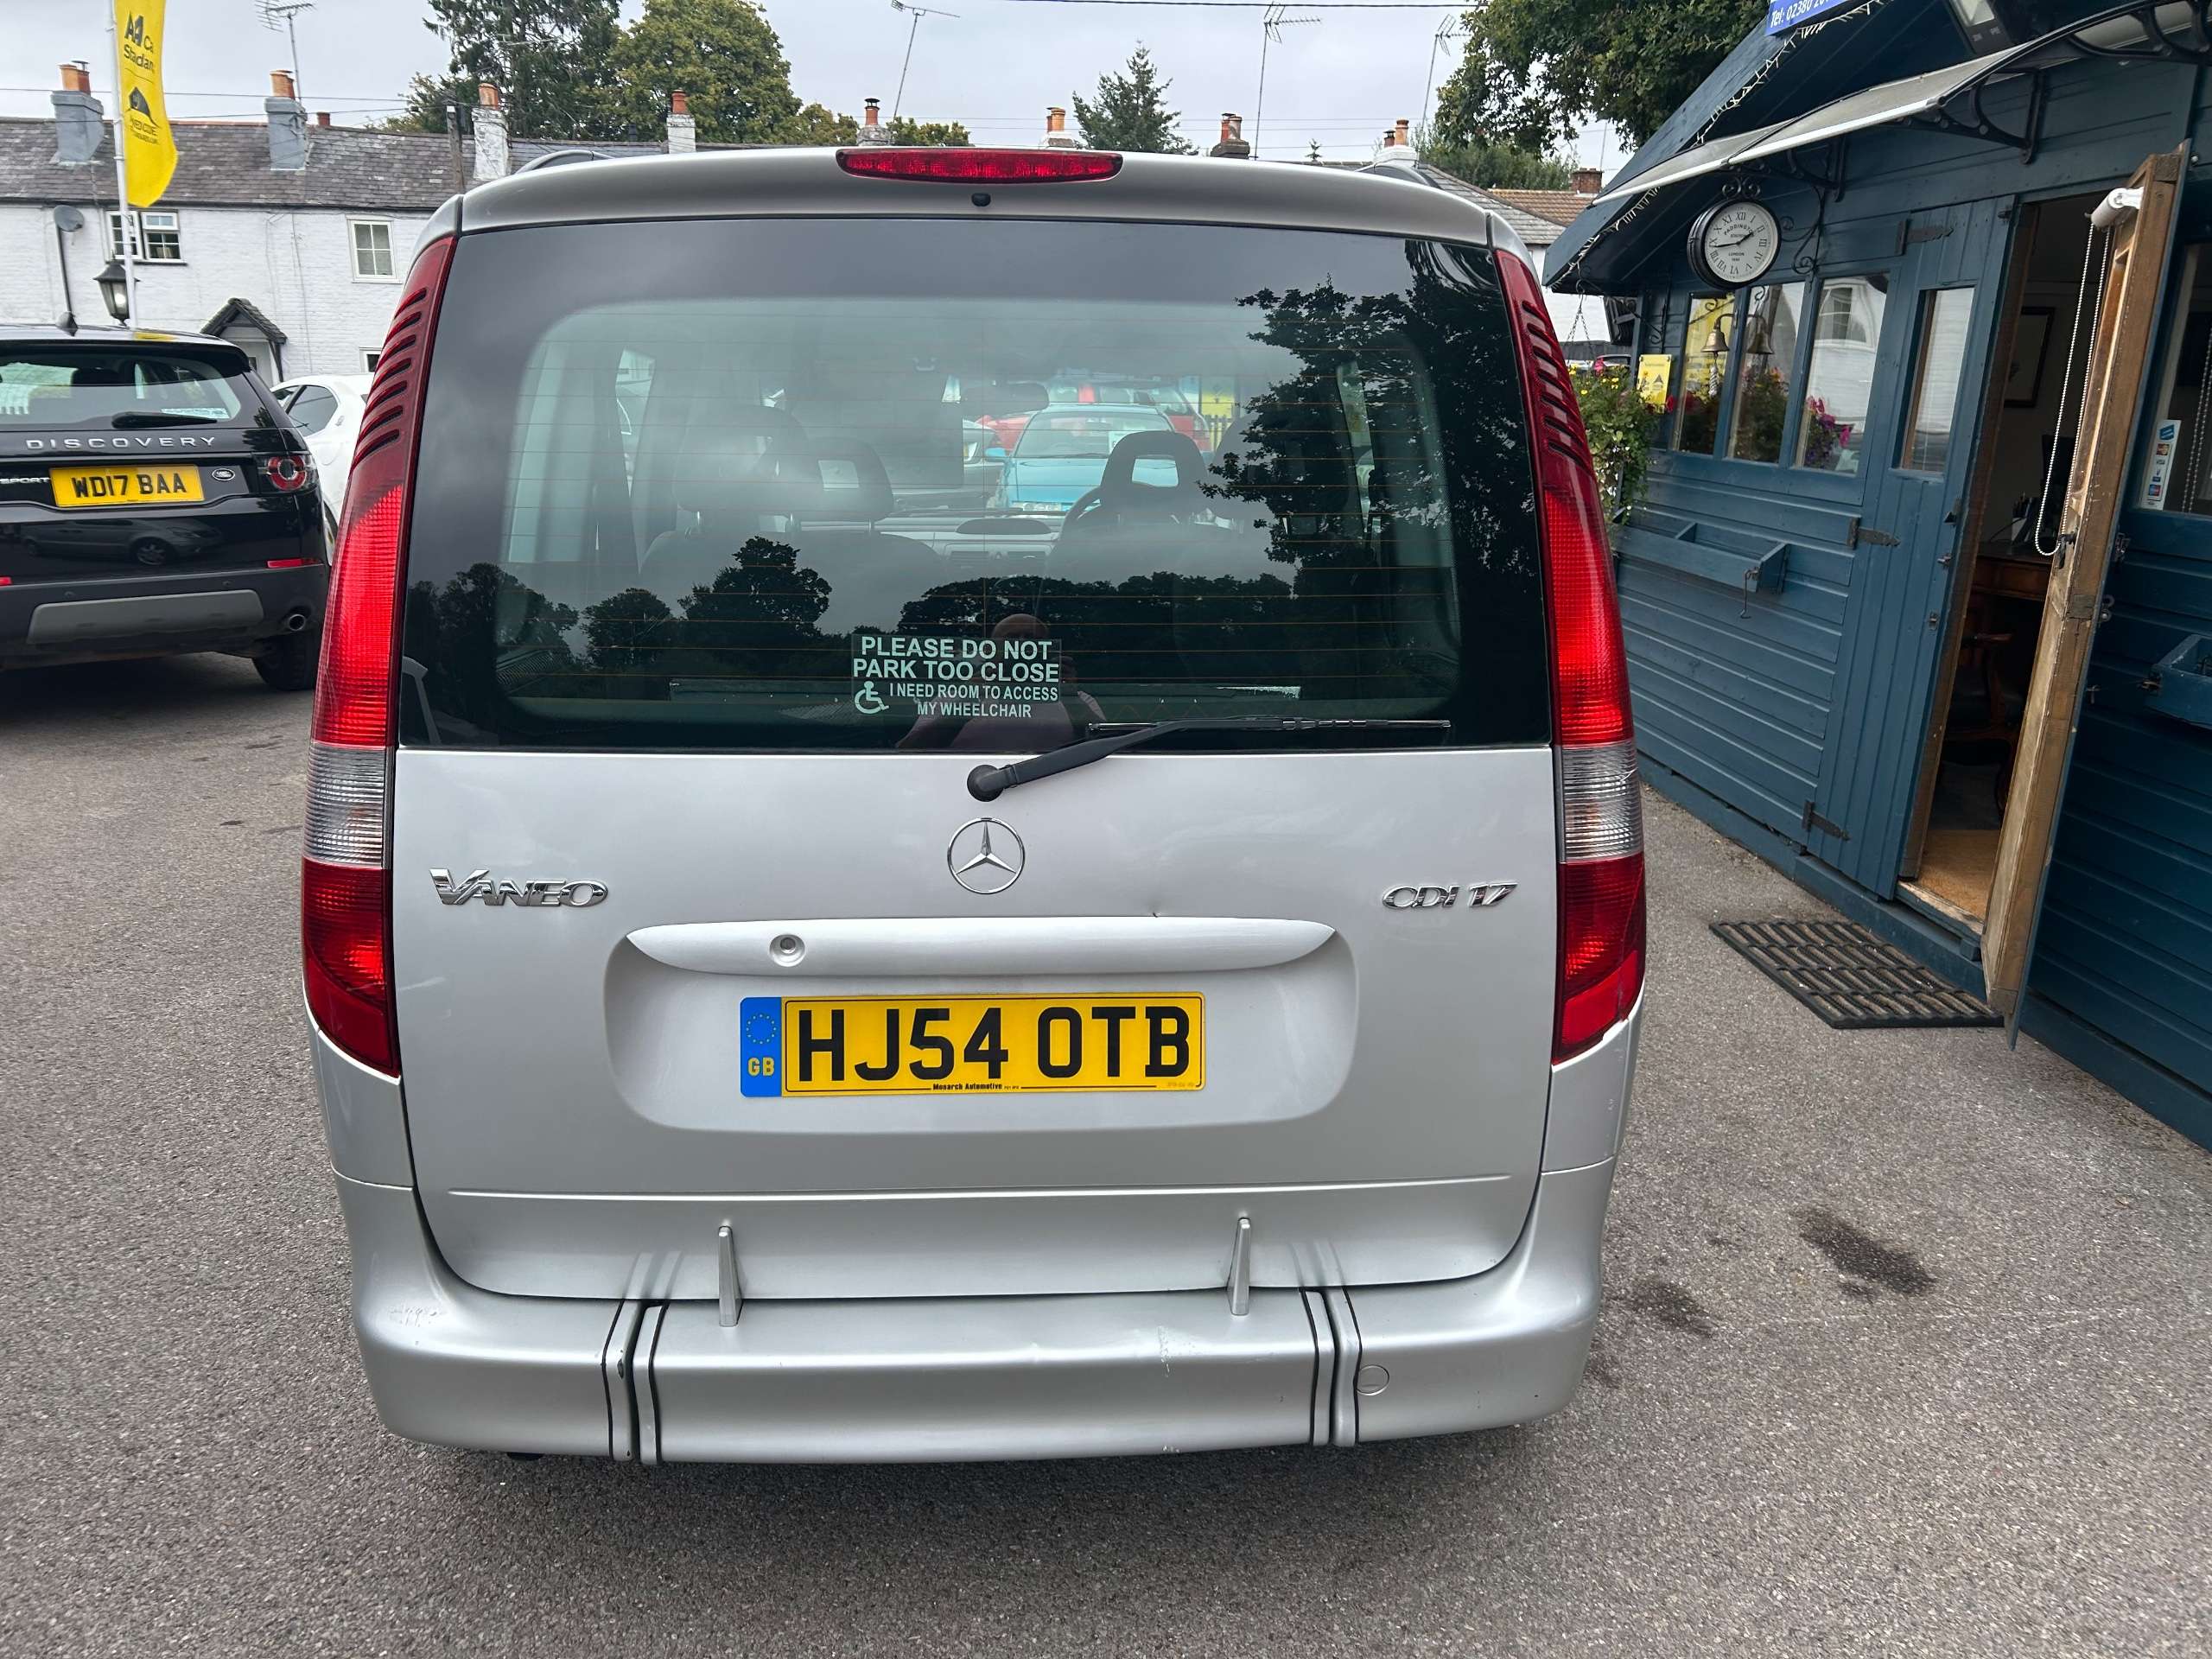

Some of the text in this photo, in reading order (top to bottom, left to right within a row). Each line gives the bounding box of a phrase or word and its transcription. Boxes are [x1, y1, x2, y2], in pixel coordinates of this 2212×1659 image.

[1770, 7, 1785, 29] Tel:
[1786, 0, 1814, 21] 02380
[1735, 212, 1746, 221] XII
[25, 436, 216, 449] DISCOVERY
[71, 473, 188, 499] WD17 BAA
[861, 636, 1052, 660] PLEASE DO NOT
[853, 658, 1059, 683] PARK TOO CLOSE
[889, 683, 1058, 702] I NEED ROOM TO ACCESS
[917, 702, 1032, 718] MY WHEELCHAIR
[429, 868, 609, 907] VANEO
[1382, 882, 1519, 908] CDI 17
[798, 1005, 1191, 1082] HJ54 OTB
[747, 1057, 775, 1077] GB
